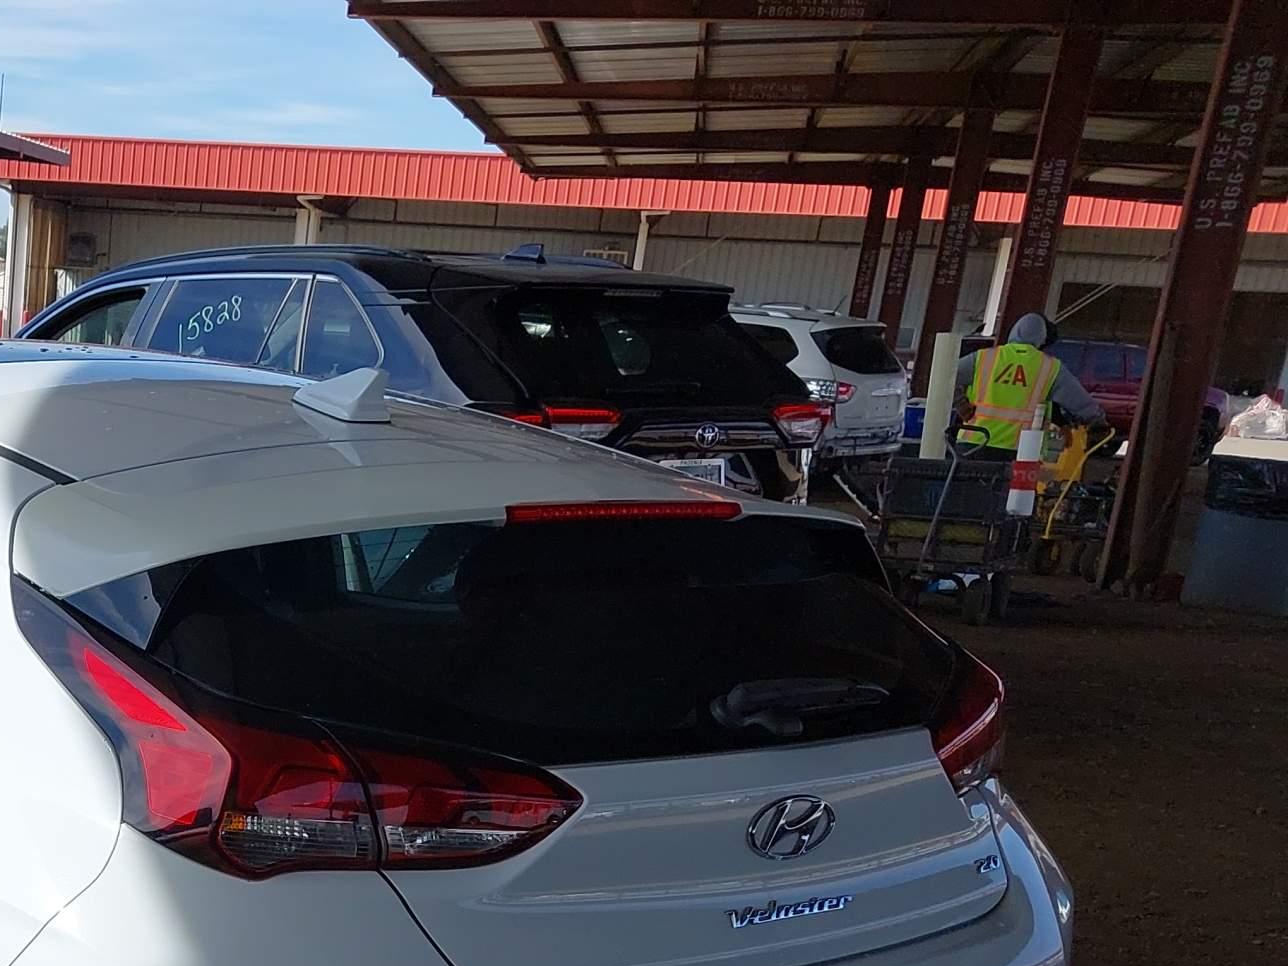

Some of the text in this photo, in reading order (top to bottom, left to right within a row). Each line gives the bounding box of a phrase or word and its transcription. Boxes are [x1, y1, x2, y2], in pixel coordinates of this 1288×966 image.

[1206, 104, 1240, 182] PREFAB
[178, 295, 243, 353] 15828
[725, 894, 854, 929] Veloster
